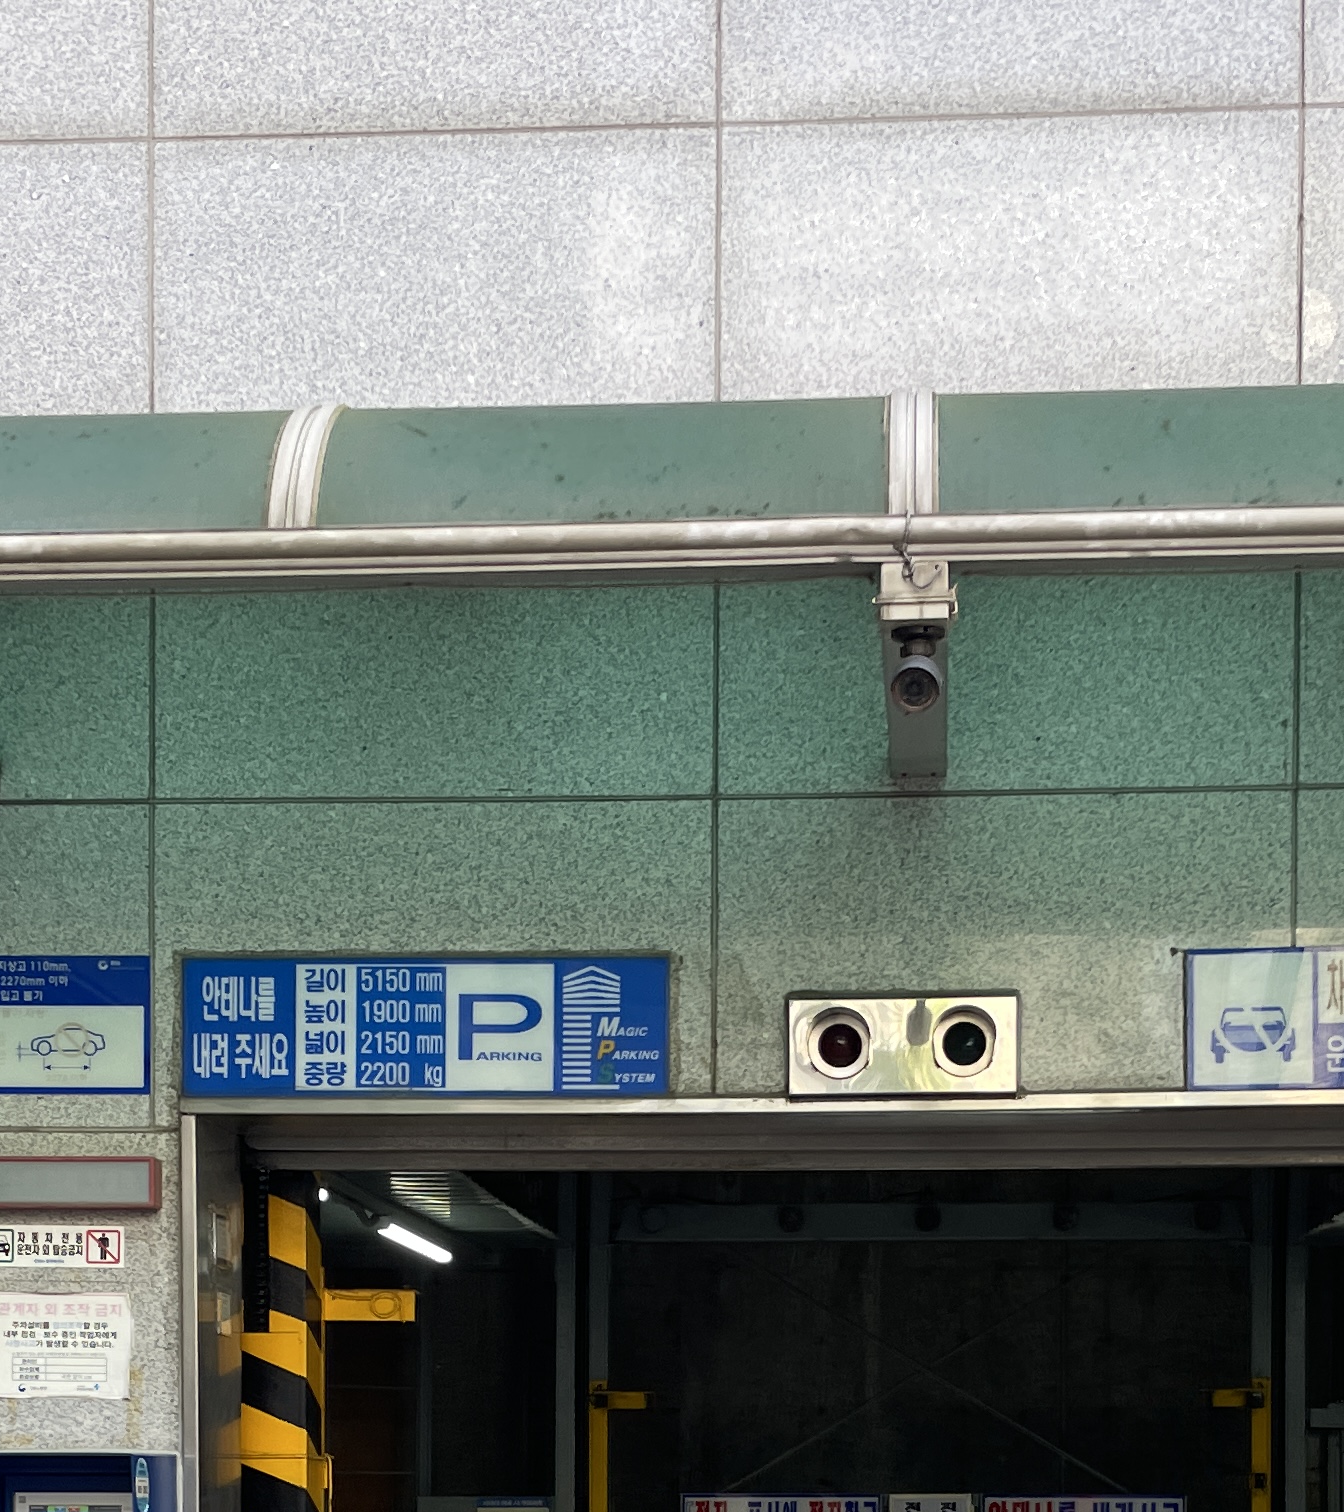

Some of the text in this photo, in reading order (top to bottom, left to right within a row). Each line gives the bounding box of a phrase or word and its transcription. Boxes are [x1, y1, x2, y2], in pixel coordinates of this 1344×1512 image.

[304, 968, 443, 993] 길이 5150 mm
[0, 989, 19, 1001] 입고
[201, 976, 275, 1021] 안테나를
[304, 999, 442, 1024] 높이 1900 mm
[193, 1032, 289, 1078] 내려 주세요
[304, 1030, 444, 1055] 넓이 2150 mm
[303, 1061, 443, 1087] 중량 2200 kg
[44, 1303, 57, 1316] 외
[62, 1303, 92, 1316] 조작
[94, 1303, 122, 1317] 금지
